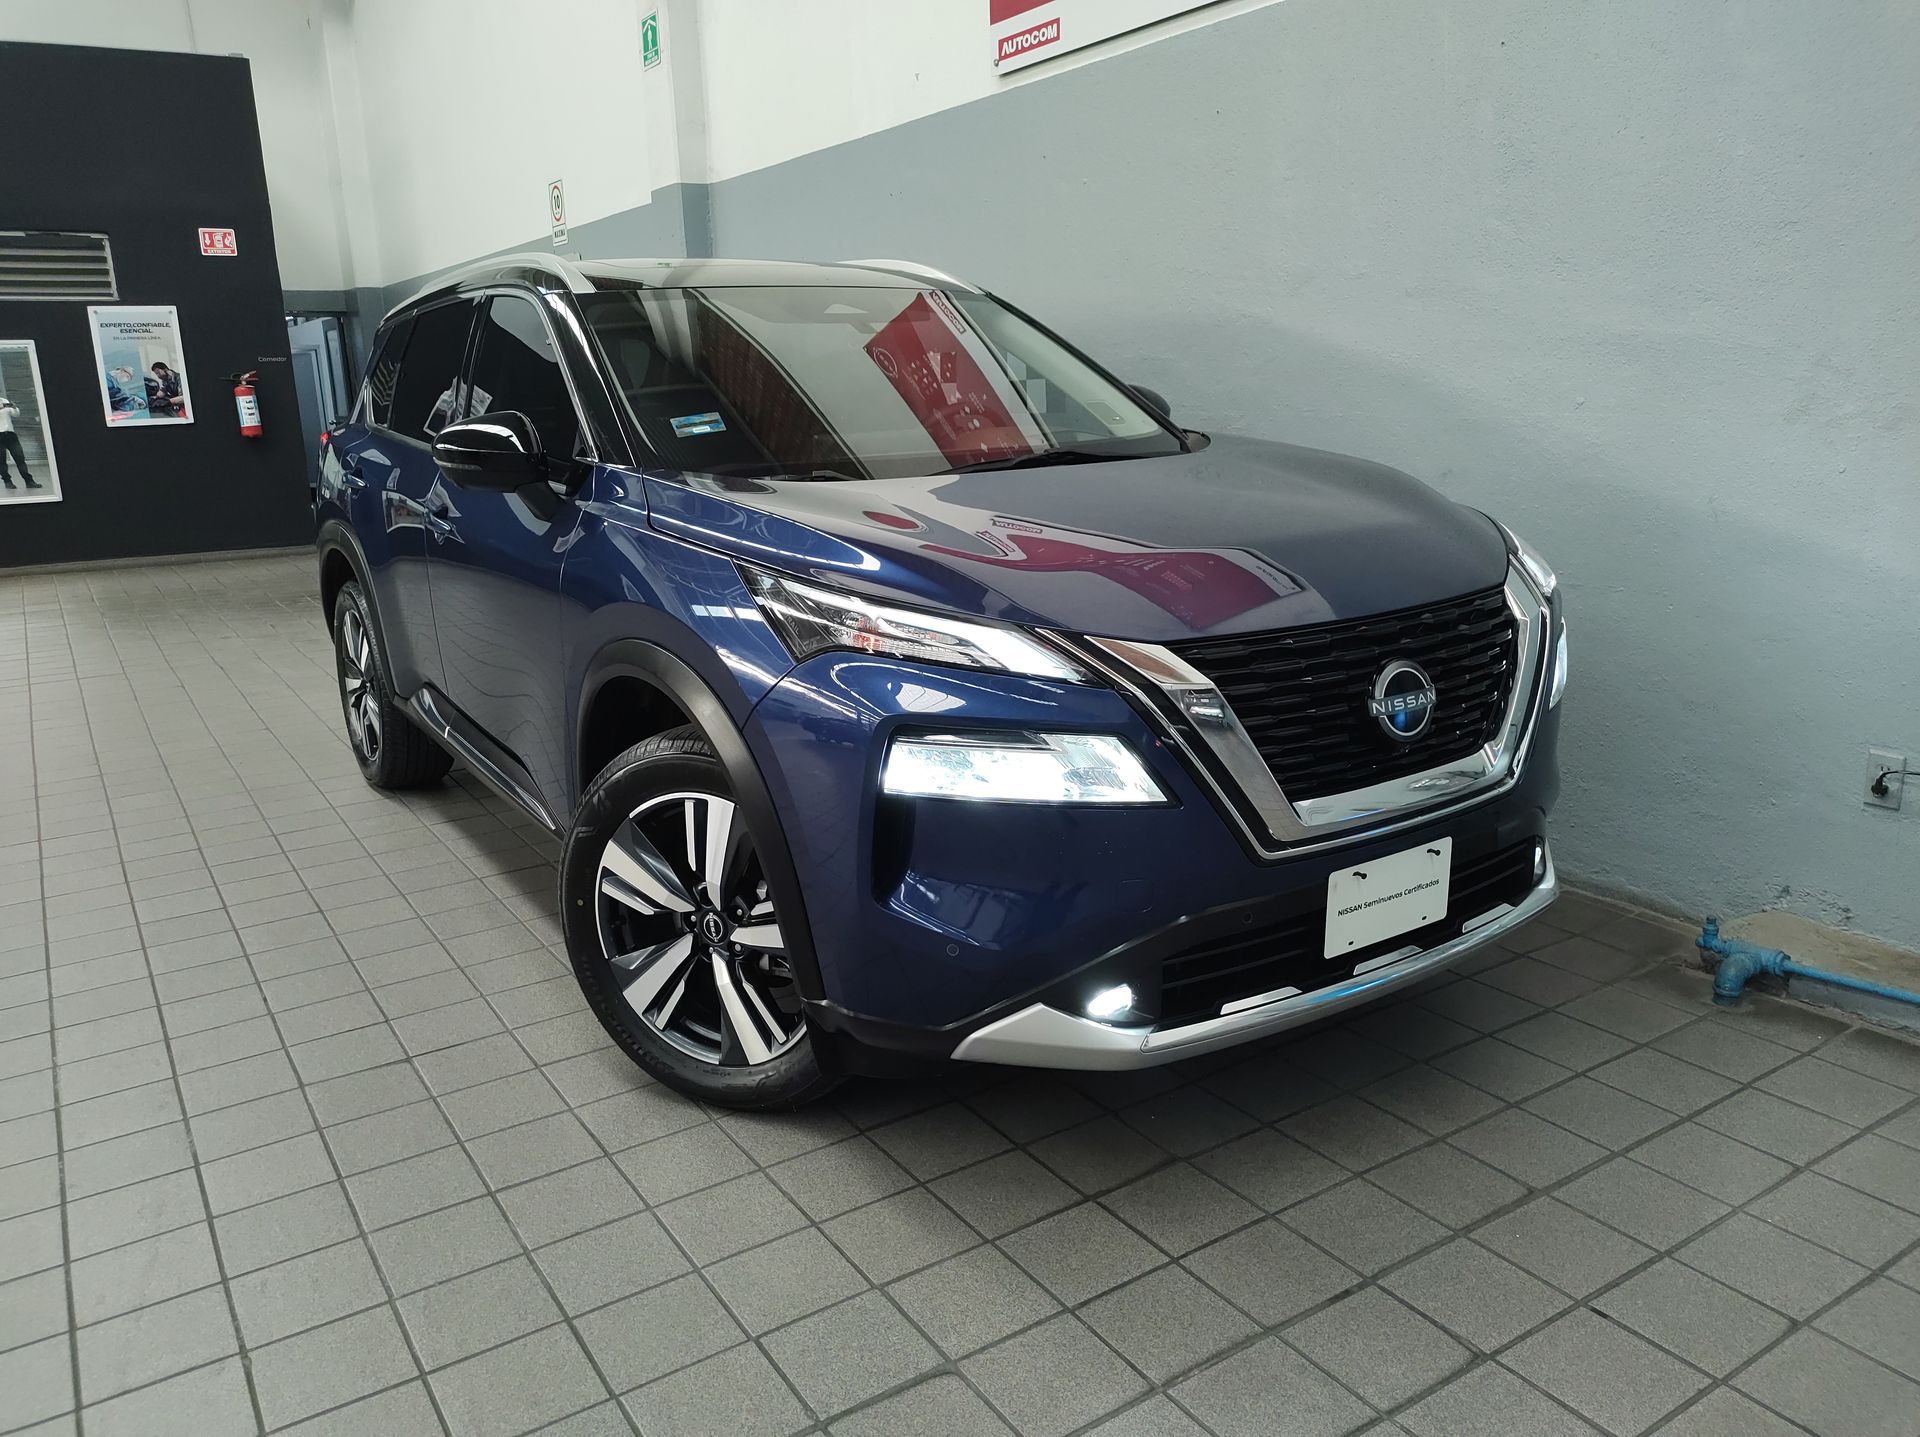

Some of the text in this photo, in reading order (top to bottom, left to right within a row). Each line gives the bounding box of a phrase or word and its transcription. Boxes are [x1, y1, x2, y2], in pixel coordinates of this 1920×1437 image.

[1001, 22, 1058, 56] AUTOCOM
[1372, 690, 1435, 715] NISSAN
[1337, 879, 1440, 917] NISSAN Seminuevos Certificados
